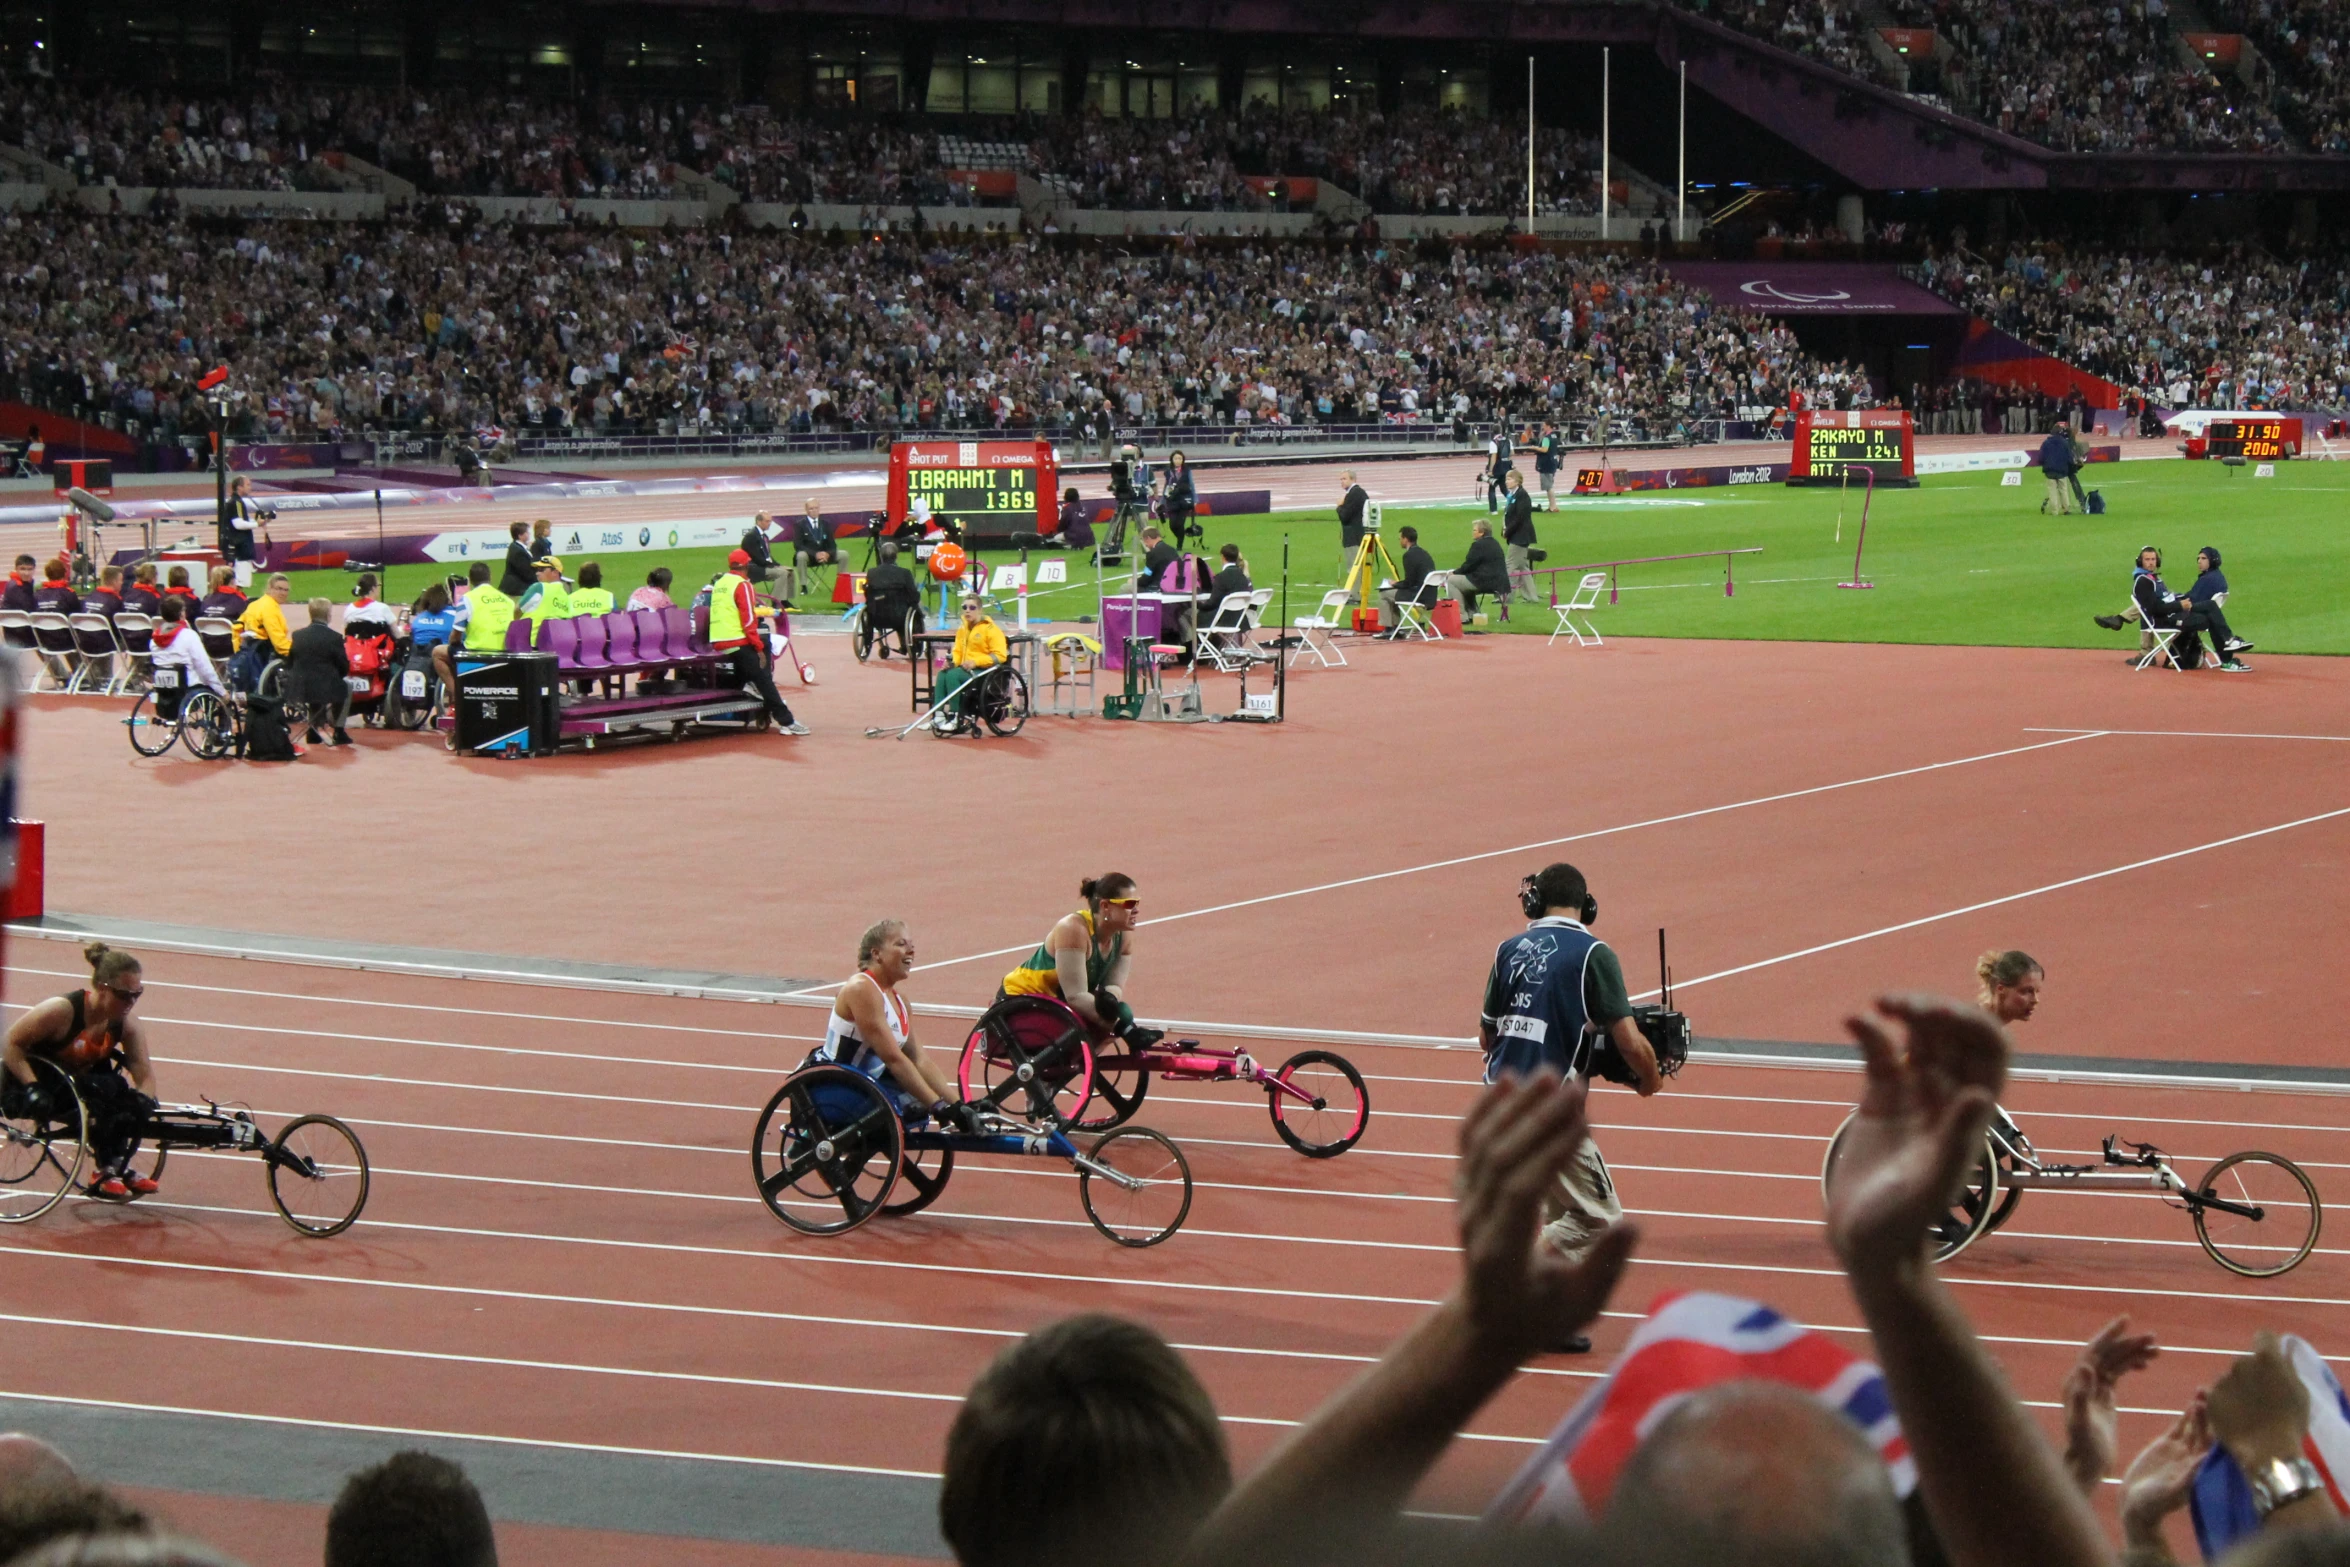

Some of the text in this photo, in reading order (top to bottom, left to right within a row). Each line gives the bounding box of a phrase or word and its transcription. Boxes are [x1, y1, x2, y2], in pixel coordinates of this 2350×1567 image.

[1749, 303, 1838, 311] Paralympic
[1810, 429, 1884, 444] ZAKAYO M
[2236, 425, 2280, 439] 31.90
[1810, 445, 1900, 458] KEN 1241
[909, 455, 949, 464] SHOT PUT
[1002, 455, 1034, 463] OMEGA
[908, 469, 1024, 489] IBRAHMI M
[1728, 466, 1771, 485] London 2012
[2006, 476, 2018, 484] 30
[986, 491, 1035, 509] 1369
[1005, 573, 1014, 586] 8
[1047, 567, 1061, 580] 10
[573, 598, 602, 609] Guide
[404, 686, 422, 696] 1197
[463, 687, 519, 696] POWERADE
[1249, 700, 1272, 709] 1161
[1241, 1057, 1251, 1074] 4
[240, 1124, 249, 1143] 7
[1030, 1140, 1040, 1155] 6
[2160, 1172, 2170, 1191] 5
